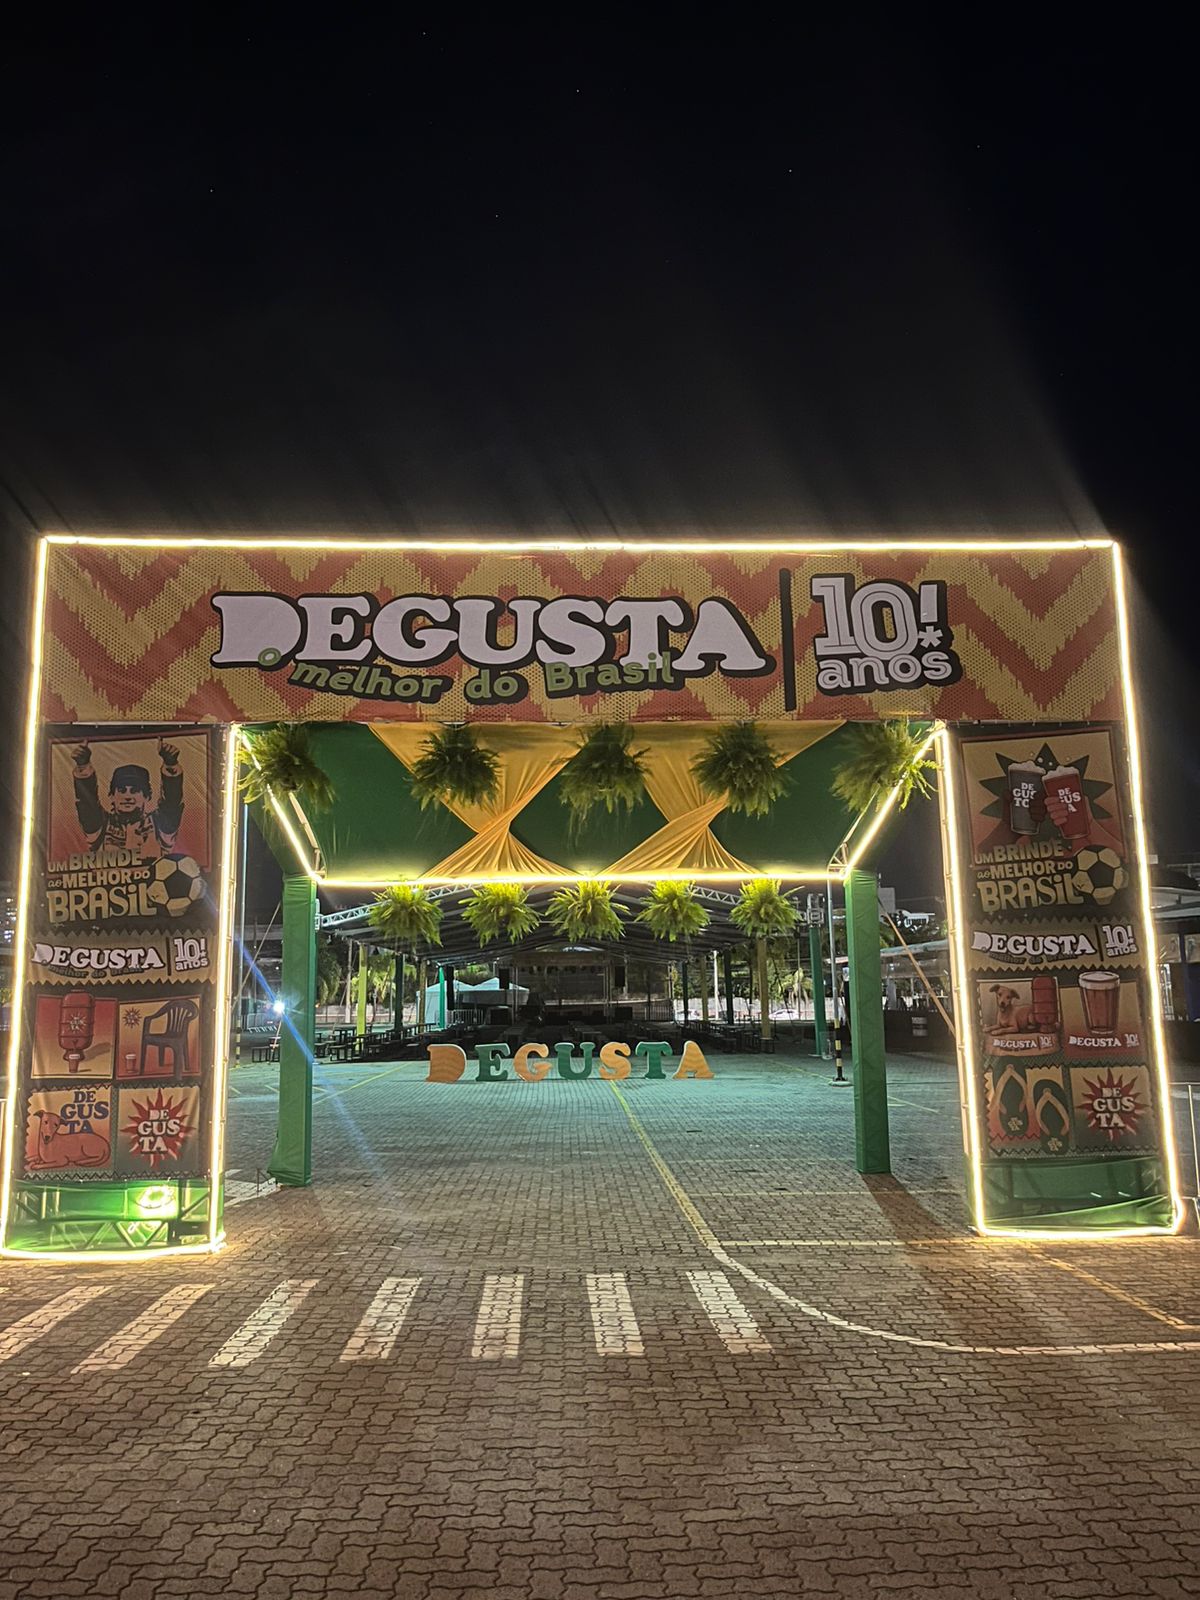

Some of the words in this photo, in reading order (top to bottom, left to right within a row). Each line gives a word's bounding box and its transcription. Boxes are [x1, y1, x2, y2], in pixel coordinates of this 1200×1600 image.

[811, 577, 943, 660] 10!
[211, 595, 767, 671] DEGUSTA
[291, 662, 442, 697] melhor
[465, 669, 519, 698] do
[547, 652, 674, 691] Brasil
[817, 651, 952, 689] anos
[47, 861, 68, 873] UM
[69, 849, 143, 871] BRINDE
[974, 852, 994, 864] UM
[994, 842, 1064, 862] BRINDE
[989, 861, 1057, 880] MELHOR
[1057, 861, 1074, 871] DO
[62, 870, 132, 889] MELHOR
[133, 870, 151, 880] DO
[971, 931, 1097, 955] DEGUSTA
[1107, 945, 1138, 957] anos
[31, 944, 165, 969] DEGUSTA
[175, 958, 208, 971] anos
[992, 1038, 1038, 1049] DEGUSTA
[1068, 1035, 1122, 1048] DEGUSTA
[425, 1041, 715, 1082] DEGUSTA
[73, 1091, 97, 1103] DE
[1101, 1087, 1122, 1097] DE
[60, 1102, 109, 1120] GUS
[1093, 1096, 1135, 1112] GUS
[149, 1109, 169, 1120] DE
[1096, 1113, 1126, 1127] TA
[63, 1120, 94, 1134] TA
[138, 1119, 181, 1135] GUS
[139, 1137, 168, 1152] TA
